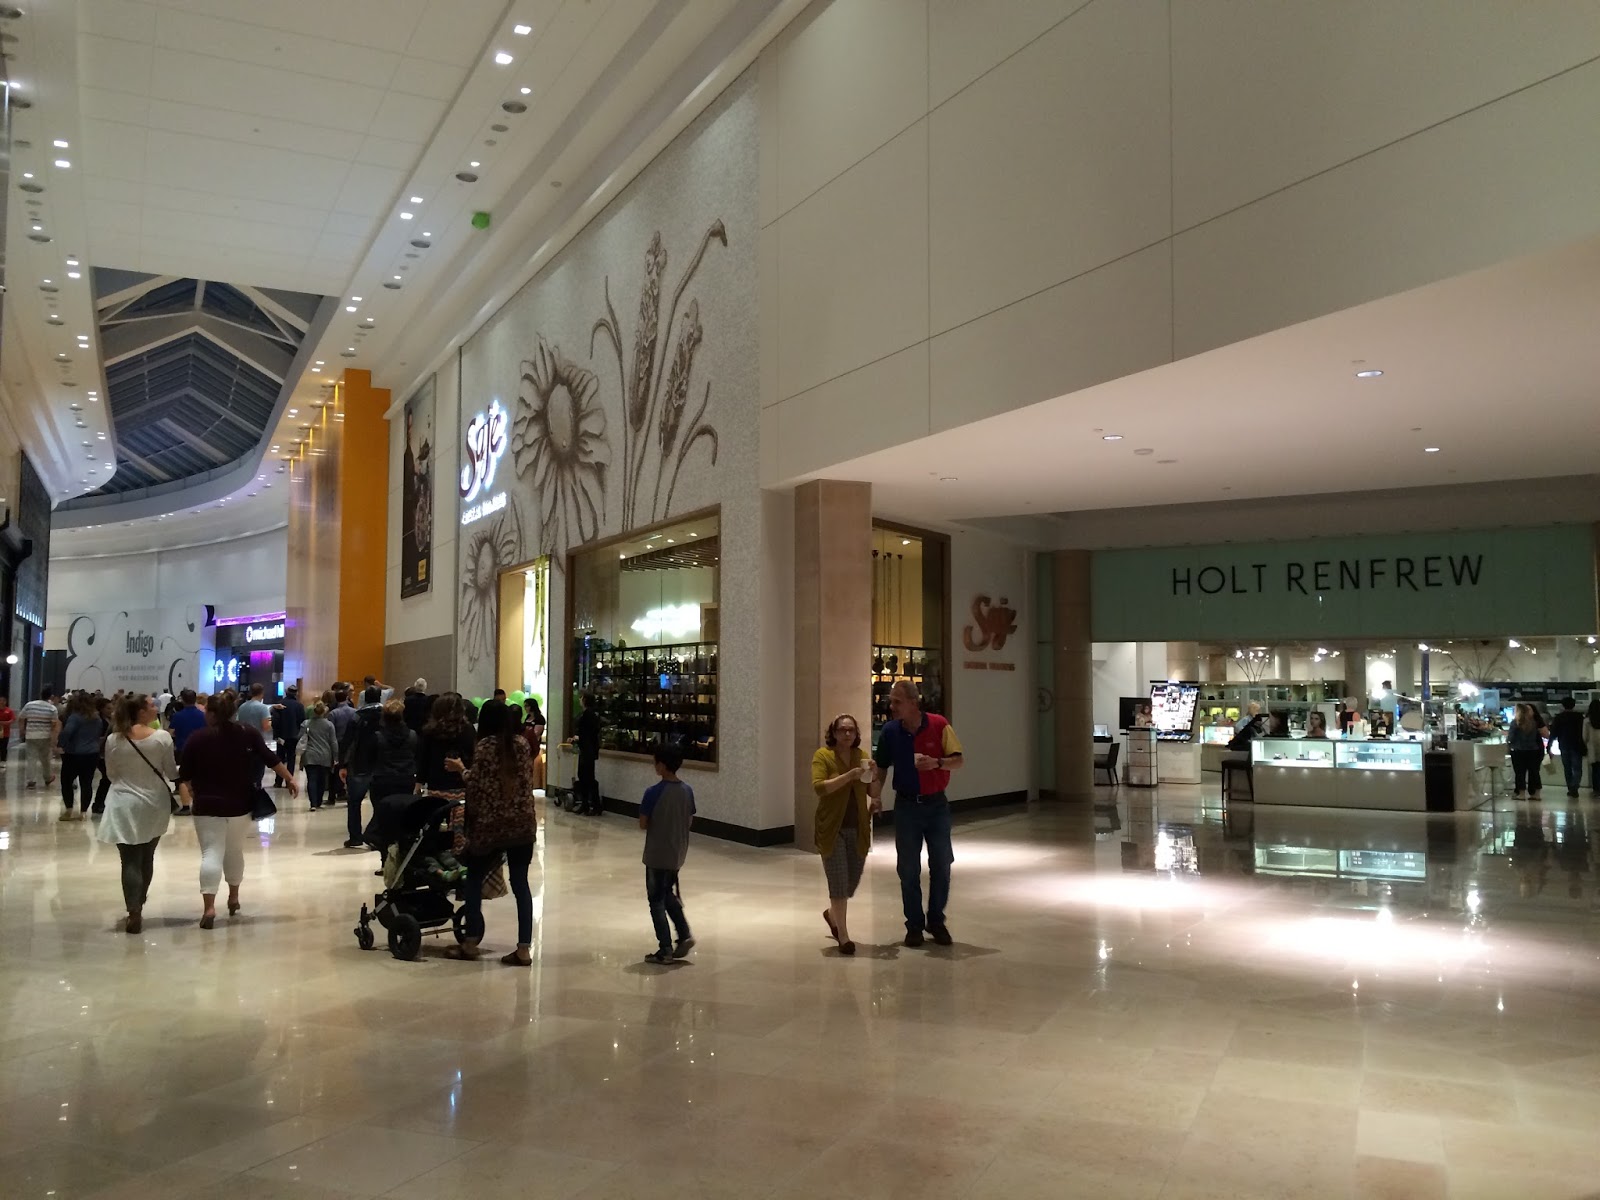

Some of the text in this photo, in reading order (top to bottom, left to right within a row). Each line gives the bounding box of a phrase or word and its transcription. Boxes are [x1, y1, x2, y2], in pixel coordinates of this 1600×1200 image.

[459, 401, 506, 500] Saje
[1172, 554, 1483, 595] HOLT RENFREW
